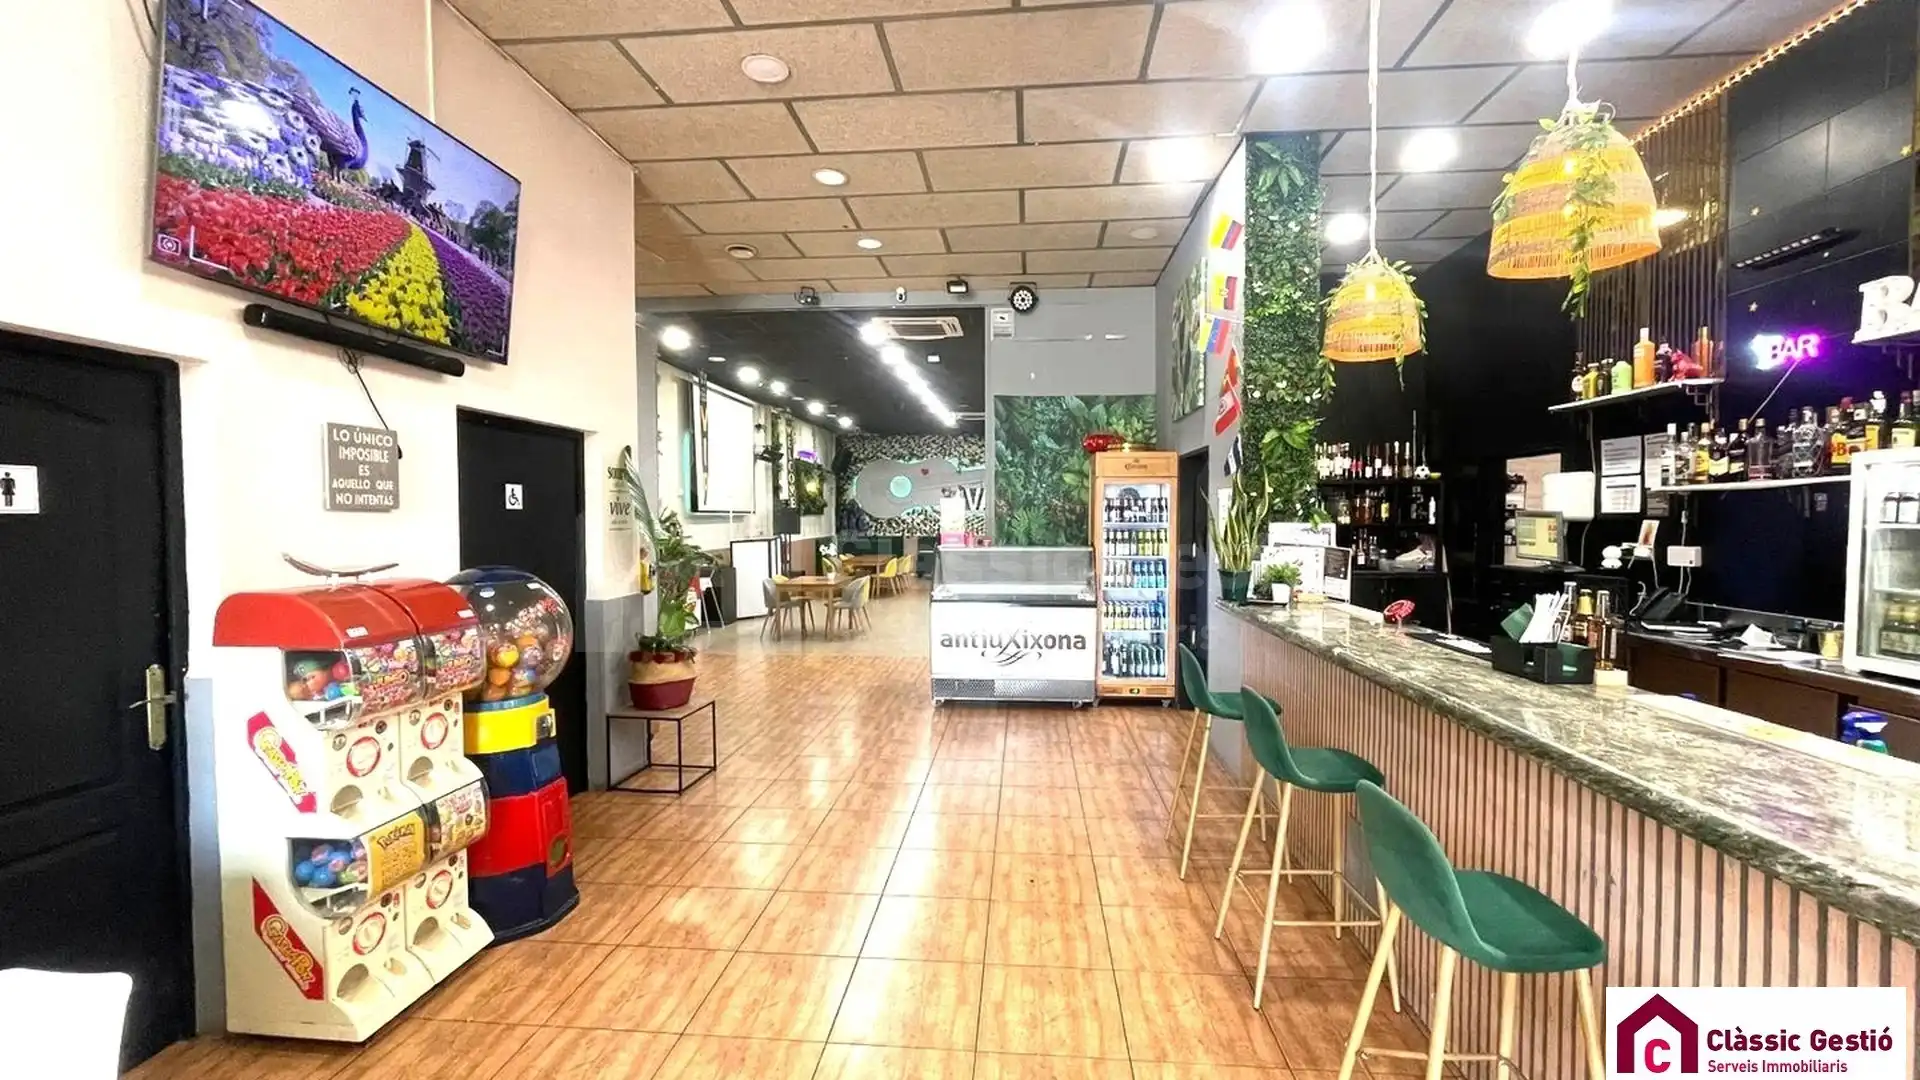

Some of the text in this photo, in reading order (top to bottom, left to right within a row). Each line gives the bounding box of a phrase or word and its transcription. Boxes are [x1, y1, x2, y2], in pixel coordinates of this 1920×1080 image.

[1852, 275, 1920, 343] B
[1767, 333, 1821, 362] BAR
[333, 427, 393, 447] LO ÚNICO
[339, 445, 389, 463] IMPOSIBLE
[358, 464, 370, 476] ES
[332, 478, 394, 490] AQUELLO QUE
[335, 493, 394, 506] NO INTENTAS
[609, 496, 631, 516] vive
